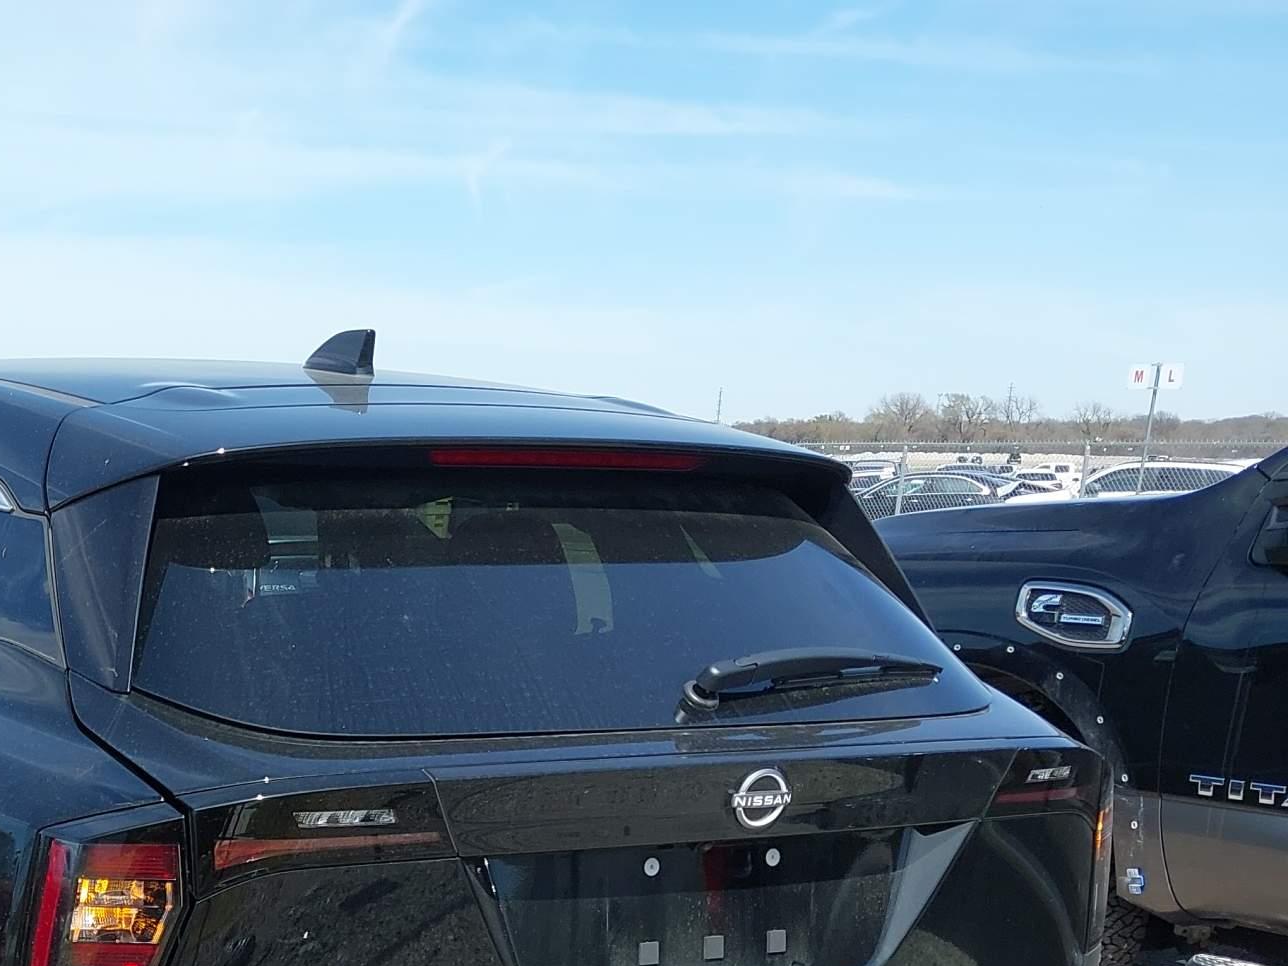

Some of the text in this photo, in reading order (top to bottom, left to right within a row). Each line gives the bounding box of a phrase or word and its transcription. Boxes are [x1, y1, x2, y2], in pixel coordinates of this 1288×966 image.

[1134, 369, 1144, 384] M
[1168, 369, 1175, 383] L
[1189, 774, 1288, 807] TIT
[734, 793, 792, 806] NISSAN
